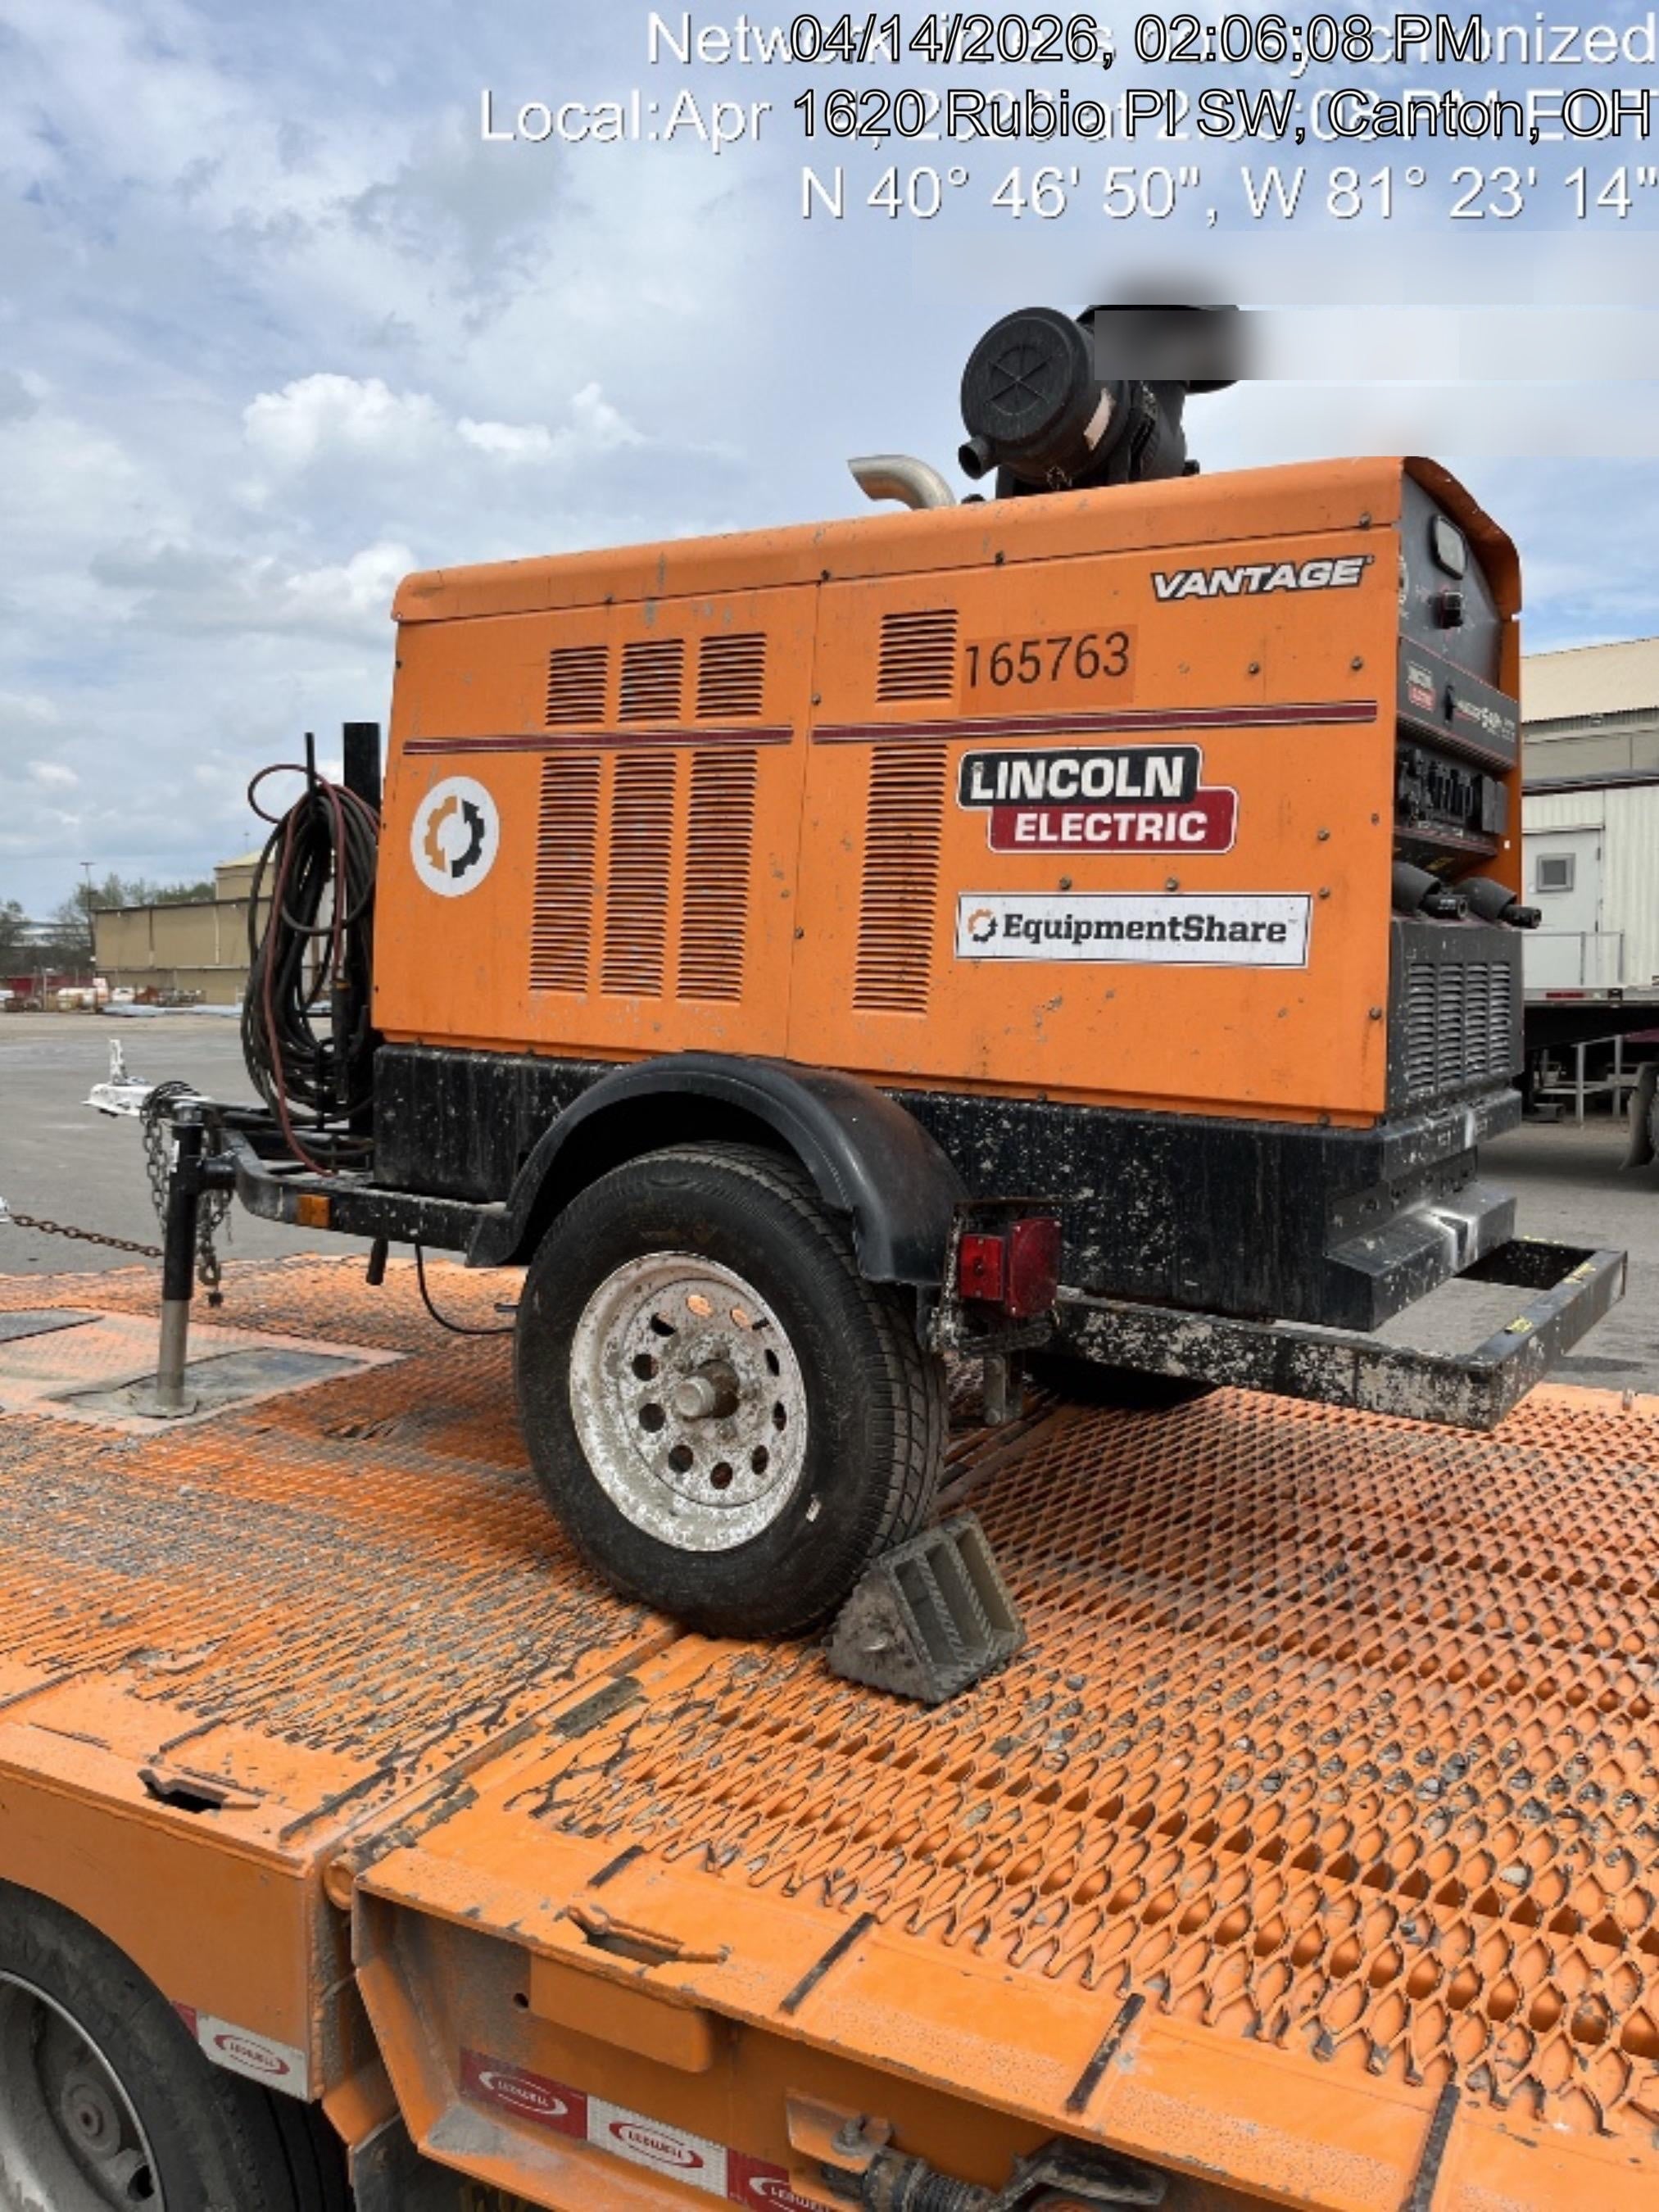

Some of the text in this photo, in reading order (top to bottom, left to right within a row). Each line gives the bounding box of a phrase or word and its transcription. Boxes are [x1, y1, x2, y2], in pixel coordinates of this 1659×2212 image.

[1151, 555, 1368, 602] VANTAGE
[965, 631, 1130, 688] 165763
[970, 755, 1186, 800] LINCOLN
[1014, 810, 1208, 843] ELECTRIC
[1002, 913, 1287, 945] EquipmentShare
